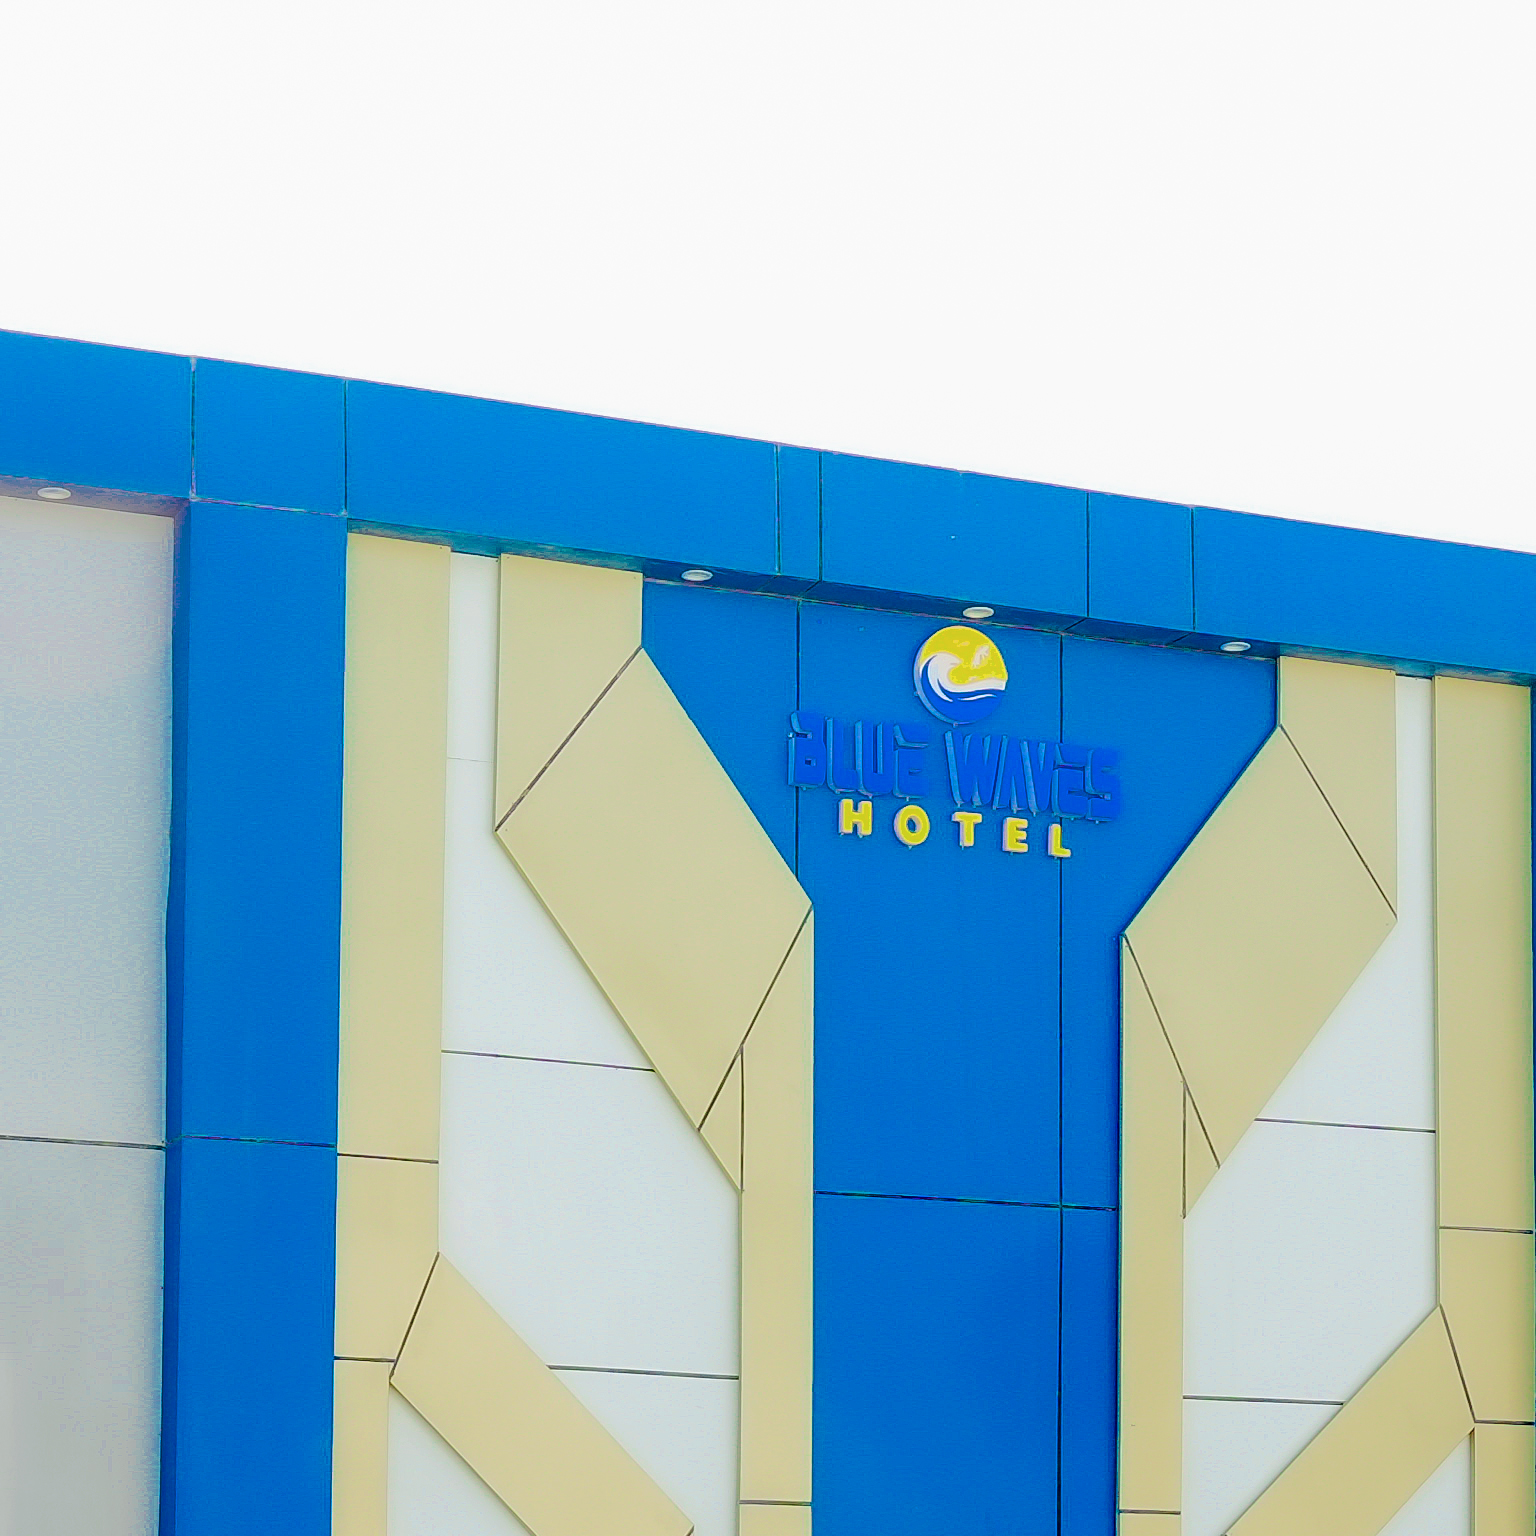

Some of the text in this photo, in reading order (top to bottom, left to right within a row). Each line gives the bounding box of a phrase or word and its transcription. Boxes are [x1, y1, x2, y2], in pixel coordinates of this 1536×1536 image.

[787, 709, 1122, 824] BLUE WAVES
[838, 798, 1072, 858] HOTEL
